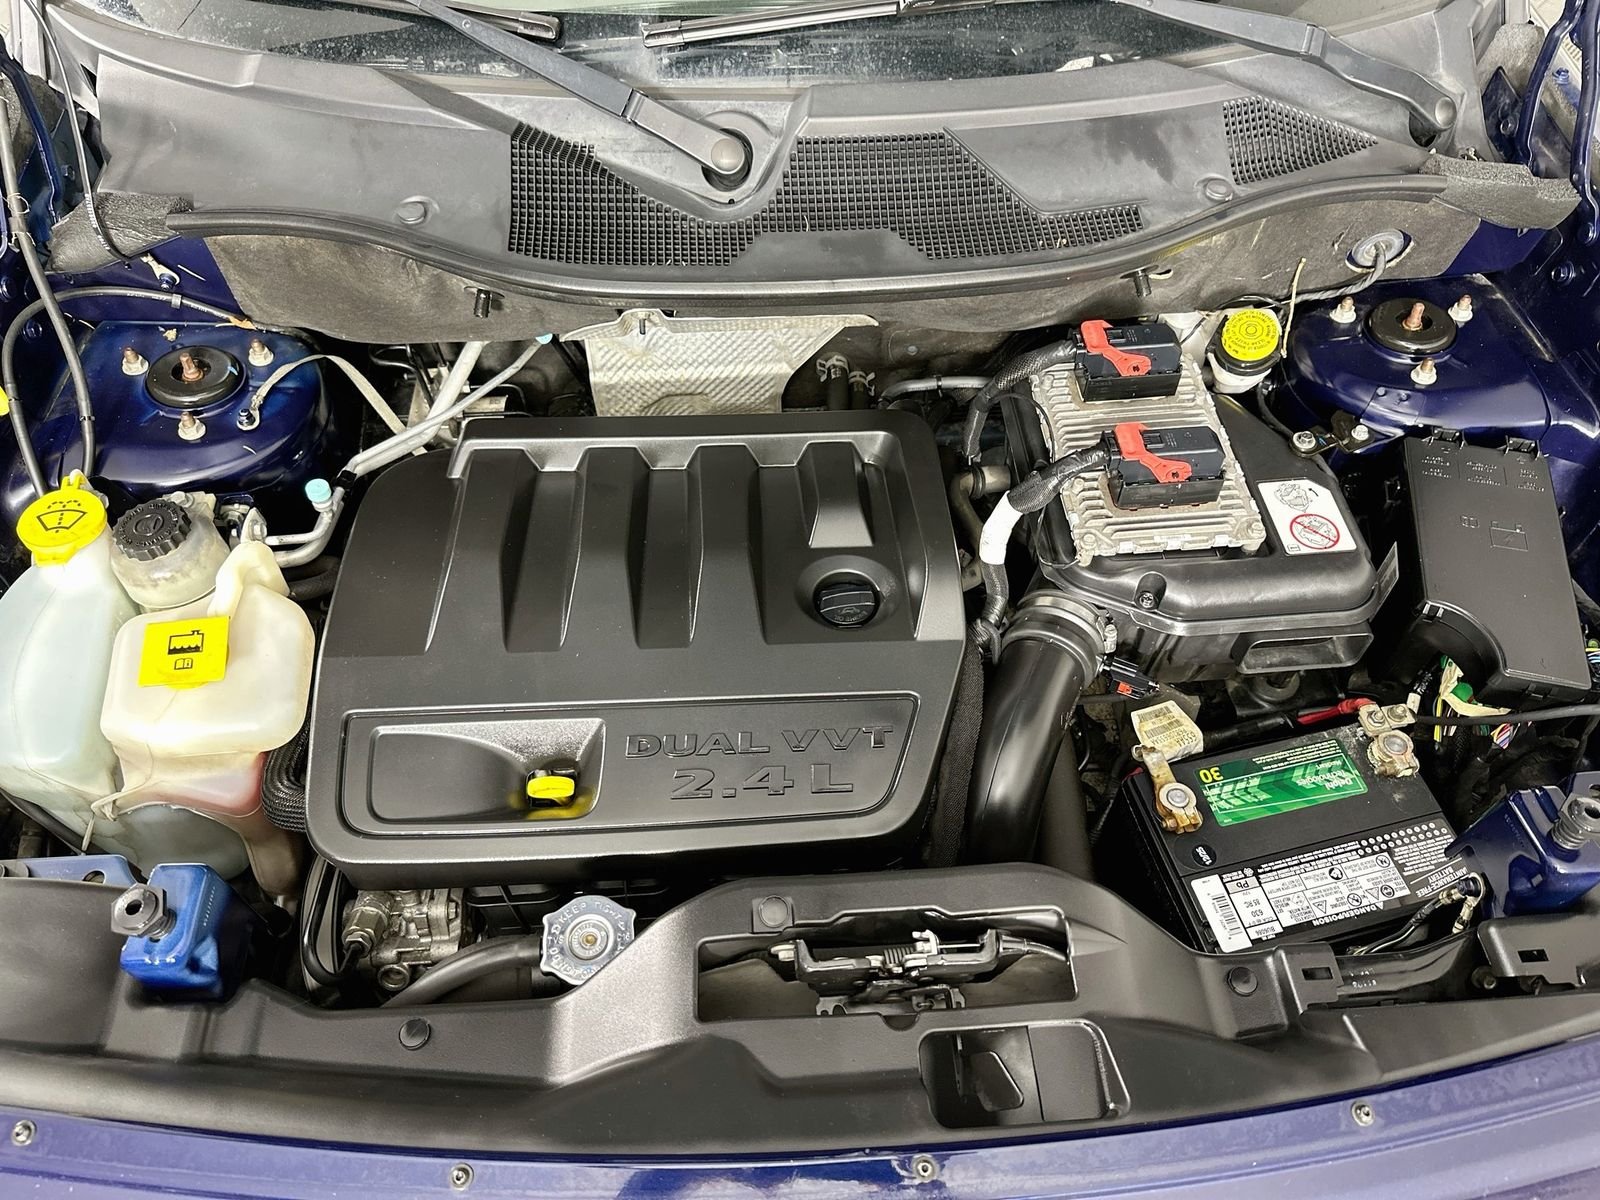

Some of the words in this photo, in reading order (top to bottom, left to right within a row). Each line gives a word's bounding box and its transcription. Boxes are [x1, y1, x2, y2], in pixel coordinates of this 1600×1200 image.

[625, 731, 770, 759] DUAL
[781, 725, 893, 752] VVT
[670, 765, 794, 800] 2.4
[810, 763, 853, 794] L
[1199, 767, 1224, 784] 30
[1296, 770, 1346, 786] Technologies
[1325, 777, 1353, 791] Delphi
[1195, 846, 1213, 865] 12/25
[1427, 866, 1454, 884] BATTERY
[1236, 880, 1249, 889] Pb
[1253, 898, 1261, 906] 85
[560, 902, 587, 923] KEEP
[1251, 909, 1264, 918] 630
[1312, 904, 1376, 926] DANGER/POISON
